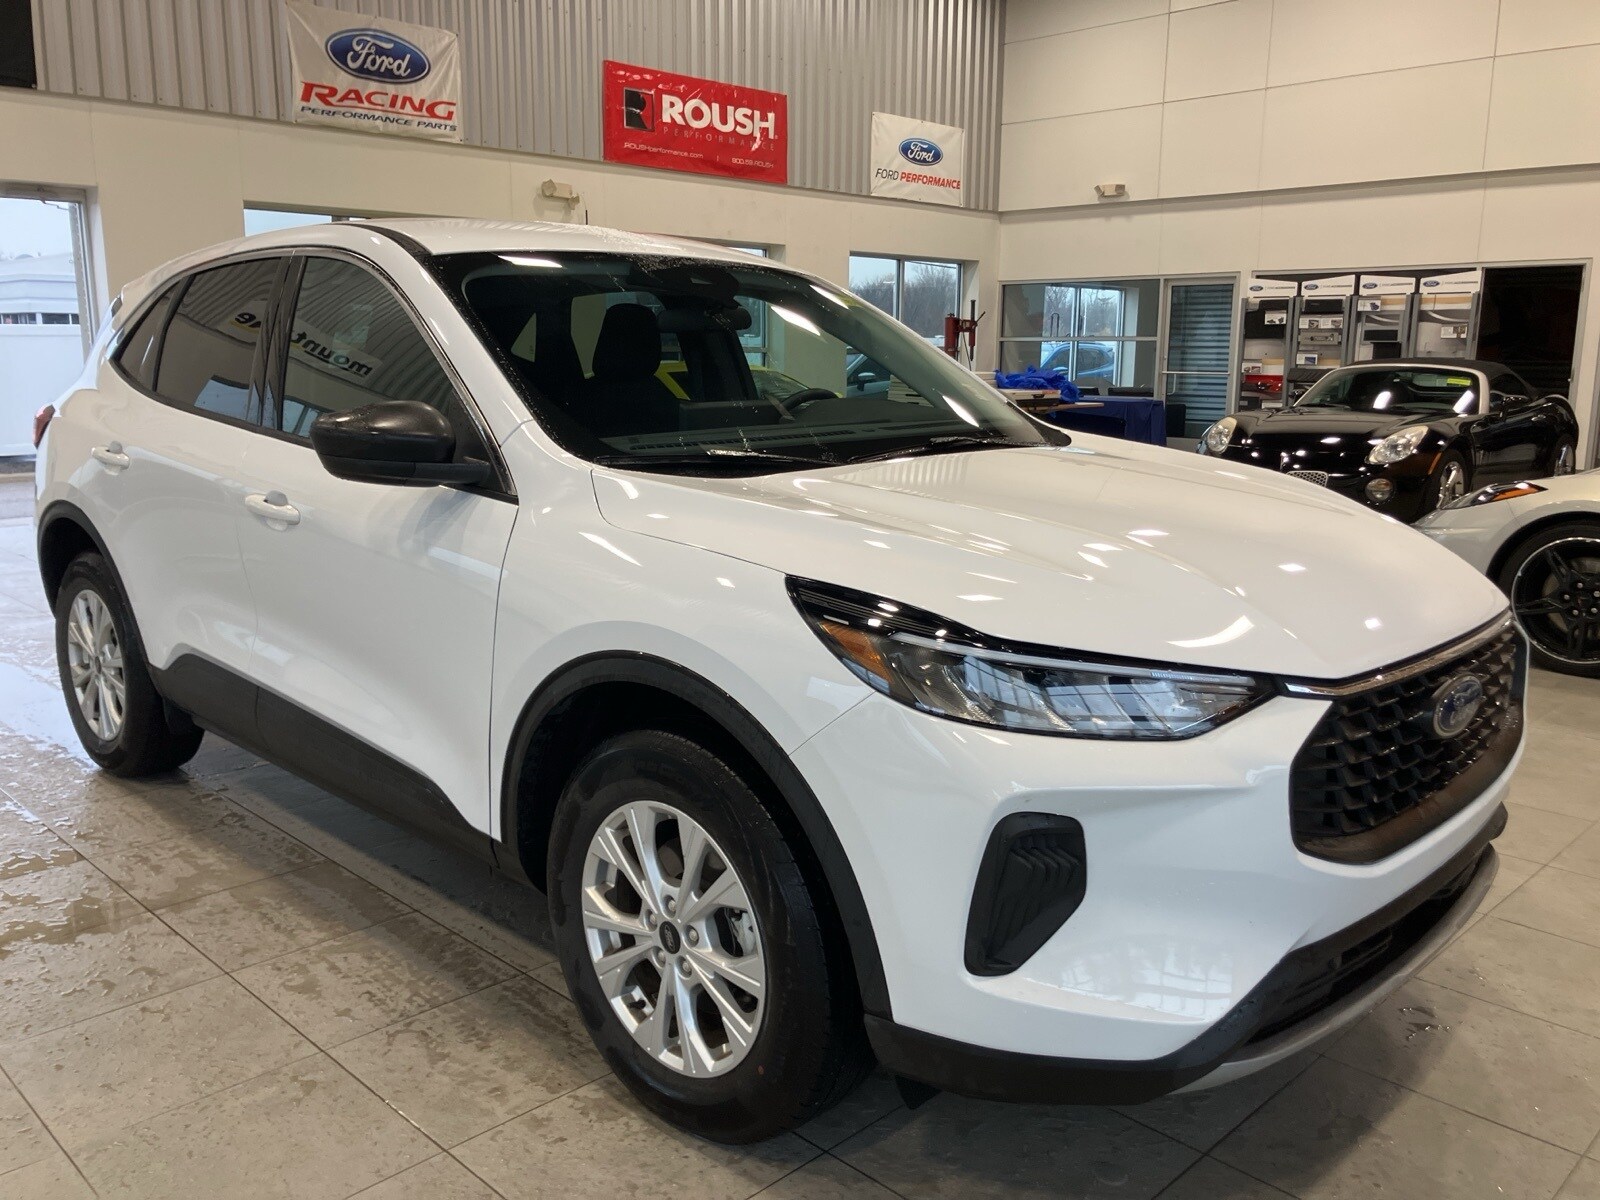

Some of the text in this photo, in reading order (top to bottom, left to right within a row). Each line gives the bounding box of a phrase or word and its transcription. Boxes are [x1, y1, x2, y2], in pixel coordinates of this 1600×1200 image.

[346, 35, 411, 77] Ford
[300, 81, 457, 120] RACING
[300, 106, 458, 132] PERFORMANCE PARTS
[661, 93, 776, 140] ROUSH
[663, 127, 775, 151] PERFORMANCE
[907, 141, 935, 162] Ford
[875, 168, 961, 190] FORD PERFORMANCE
